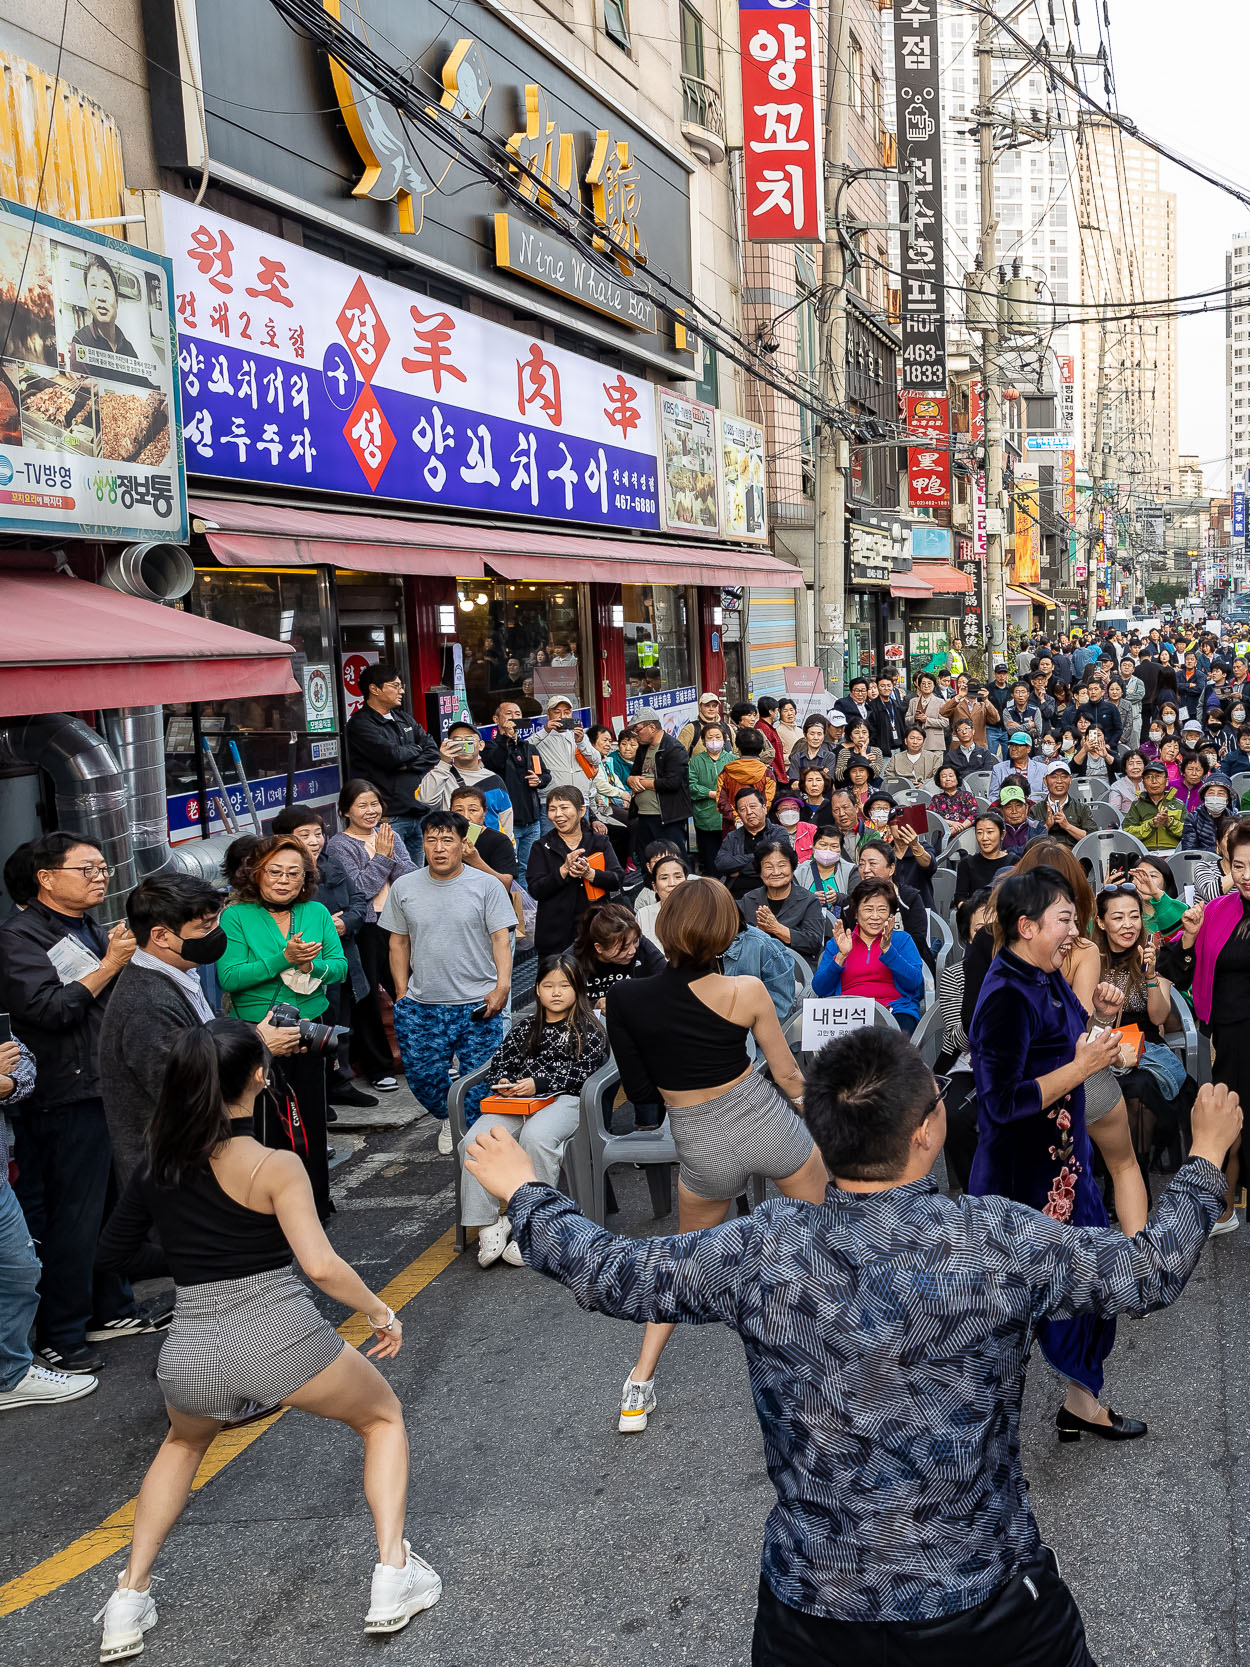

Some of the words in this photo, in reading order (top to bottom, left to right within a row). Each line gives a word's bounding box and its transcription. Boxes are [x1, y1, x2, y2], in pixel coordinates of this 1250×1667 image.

[749, 23, 810, 231] 양꼬치
[187, 225, 294, 309] 원조
[519, 231, 565, 283] Nine
[571, 259, 622, 310] Whale
[628, 294, 652, 323] Bar
[906, 315, 940, 333] HOF
[401, 304, 641, 441] 羊肉串
[904, 345, 944, 362] 463-
[329, 358, 350, 396] 구
[904, 366, 943, 383] 1833
[183, 408, 317, 473] 선두주자
[413, 405, 609, 515] 양꼬치구이
[614, 494, 656, 514] 467-6880
[813, 1007, 867, 1025] 내빈석
[290, 1101, 300, 1127] Canon
